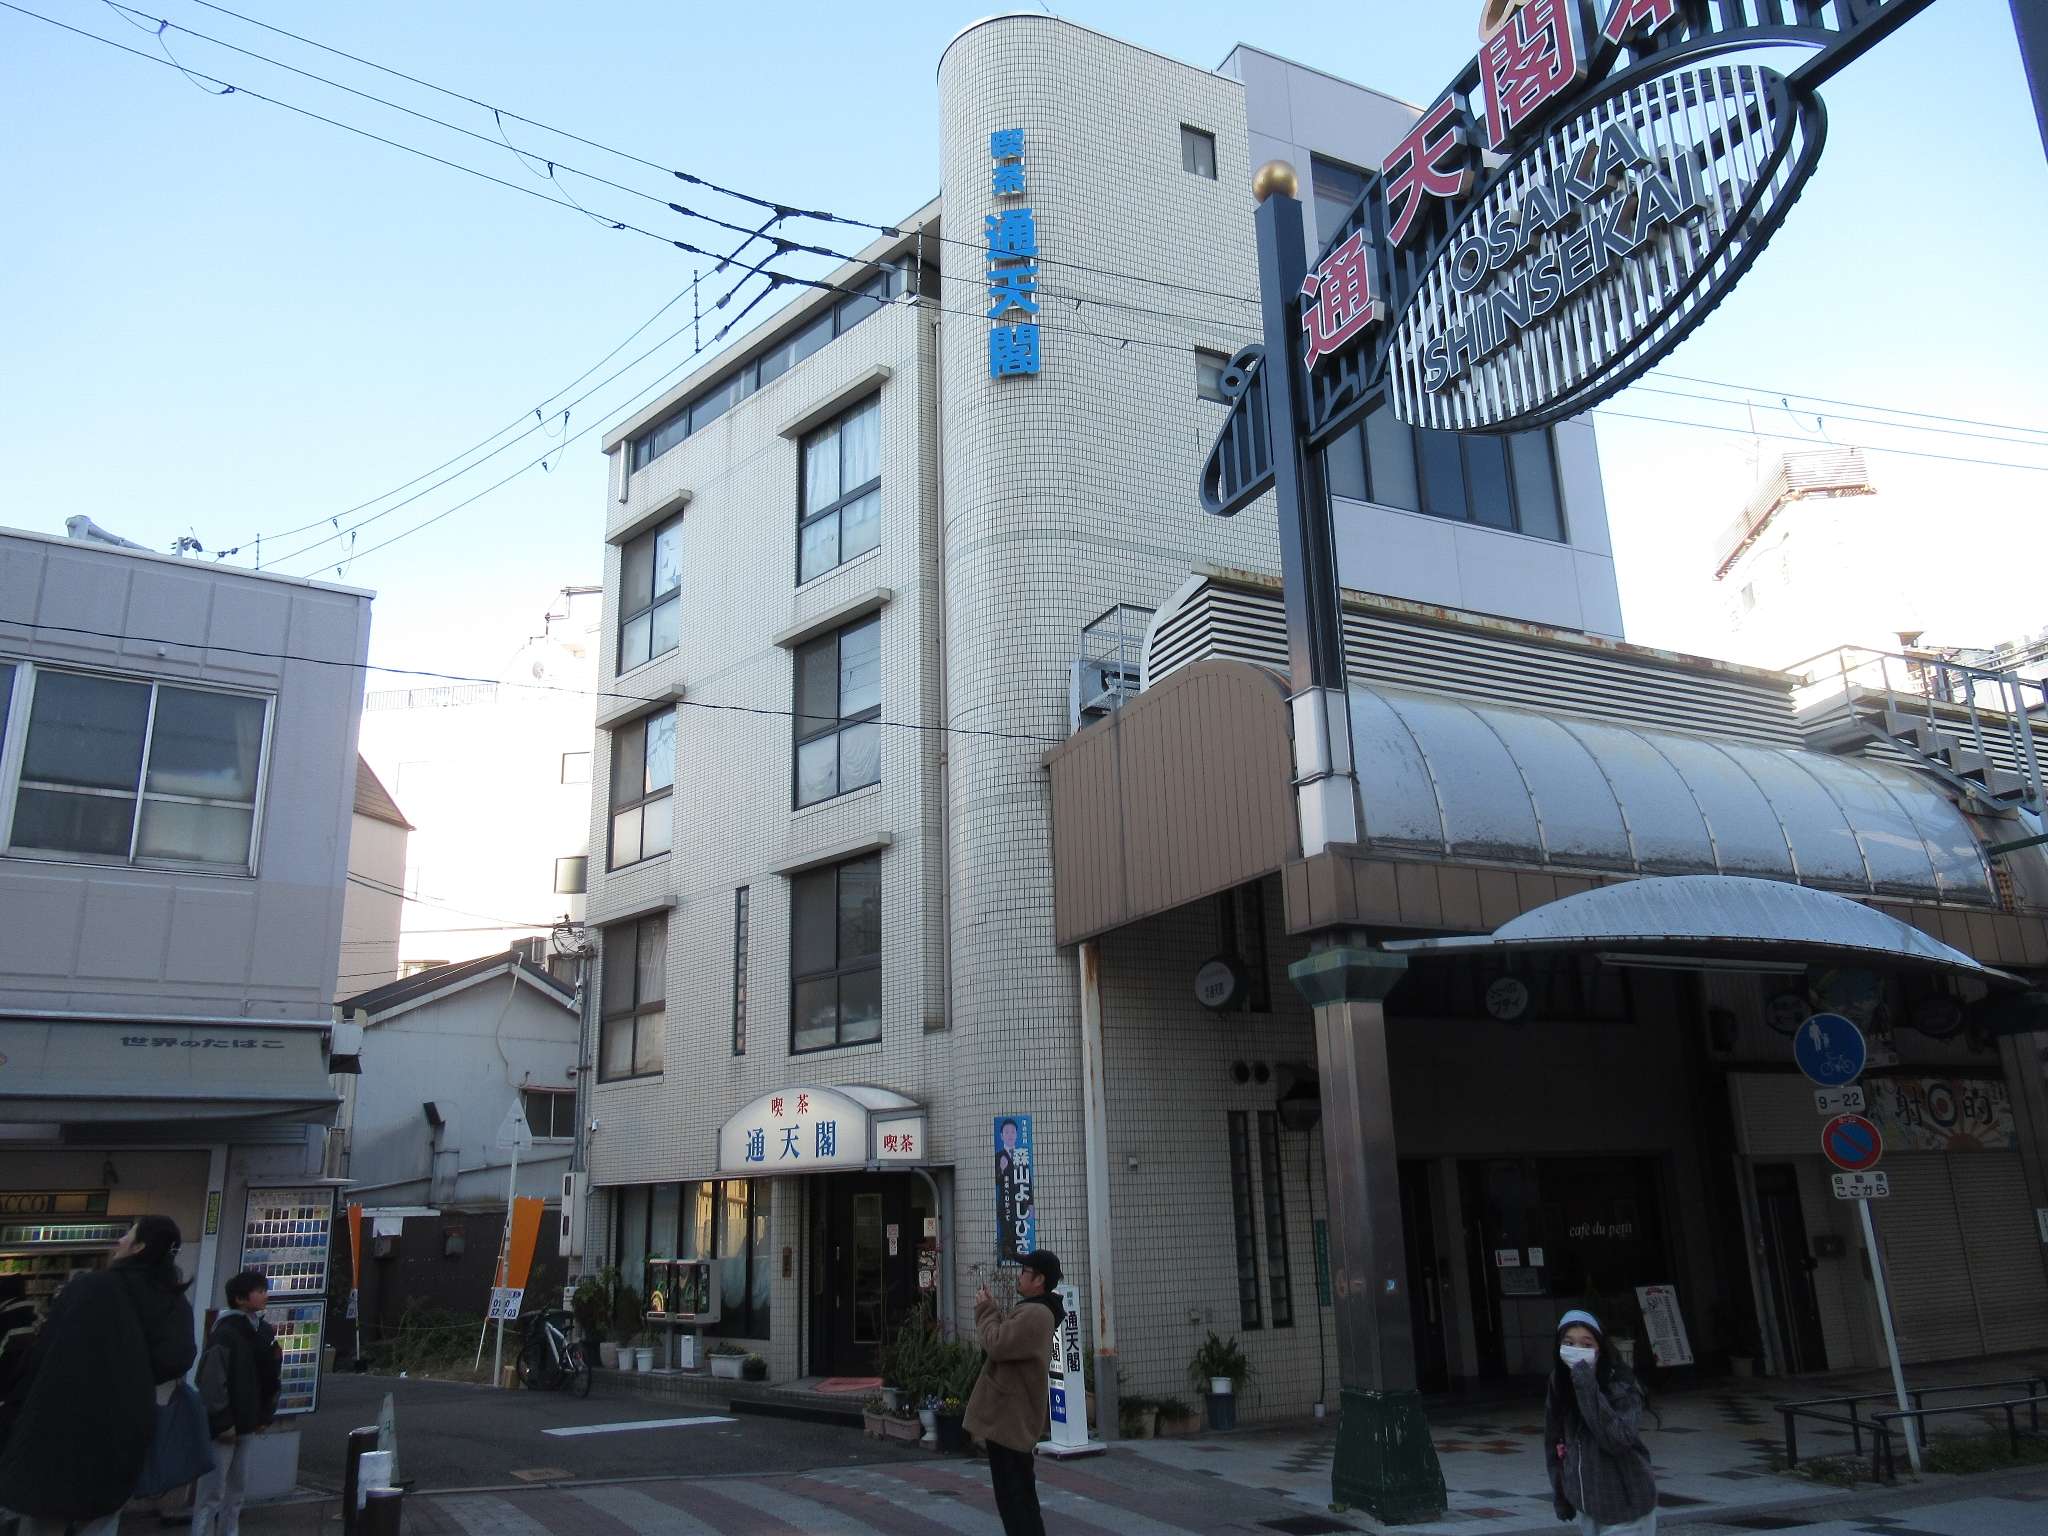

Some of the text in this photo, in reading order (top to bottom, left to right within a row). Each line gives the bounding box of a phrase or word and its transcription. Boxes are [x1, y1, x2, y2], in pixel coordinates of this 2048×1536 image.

[1449, 121, 1648, 297] OSAKA
[984, 207, 1041, 380] 通天閣
[1423, 149, 1699, 396] SHINSEKAI
[771, 1093, 809, 1117] 喫茶
[1818, 1092, 1861, 1110] 9-22
[745, 1119, 838, 1163] 通天閣
[883, 1133, 914, 1153] 喫茶
[1012, 1147, 1031, 1255] 森山よしひさ
[1836, 1184, 1888, 1197] ここから
[1593, 1219, 1606, 1236] du
[1065, 1311, 1081, 1374] 通天閣
